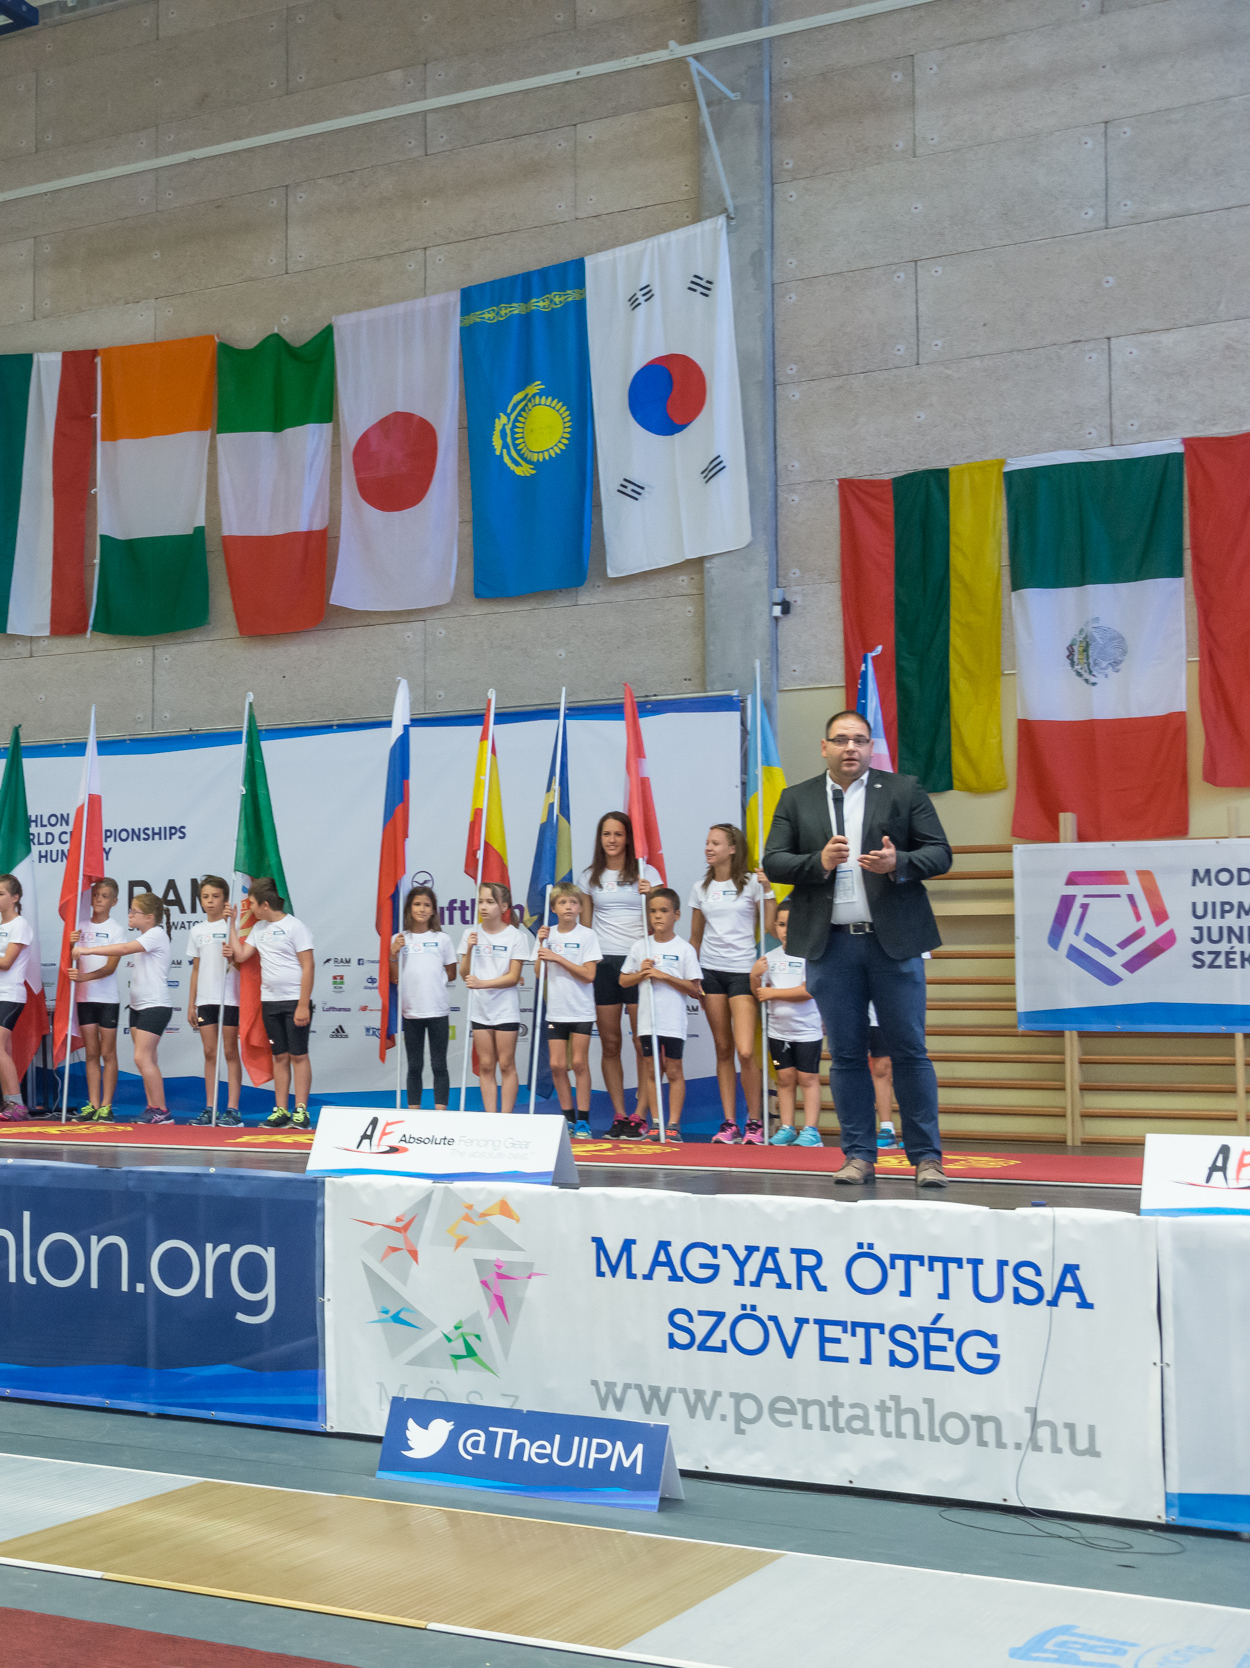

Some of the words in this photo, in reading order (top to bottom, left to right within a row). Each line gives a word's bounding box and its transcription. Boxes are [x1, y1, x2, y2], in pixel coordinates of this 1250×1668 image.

[1191, 867, 1250, 887] MOD
[398, 1134, 455, 1146] Absolute
[458, 1135, 501, 1150] Fencing
[503, 1137, 531, 1150] Gear
[591, 1236, 828, 1292] MAGYAR
[844, 1242, 1095, 1310] ÖTTUSA
[667, 1303, 1001, 1376] SZÖVETSÉG
[591, 1379, 1102, 1459] www.pentathlon.hu
[458, 1426, 644, 1475] @TheUIPM
